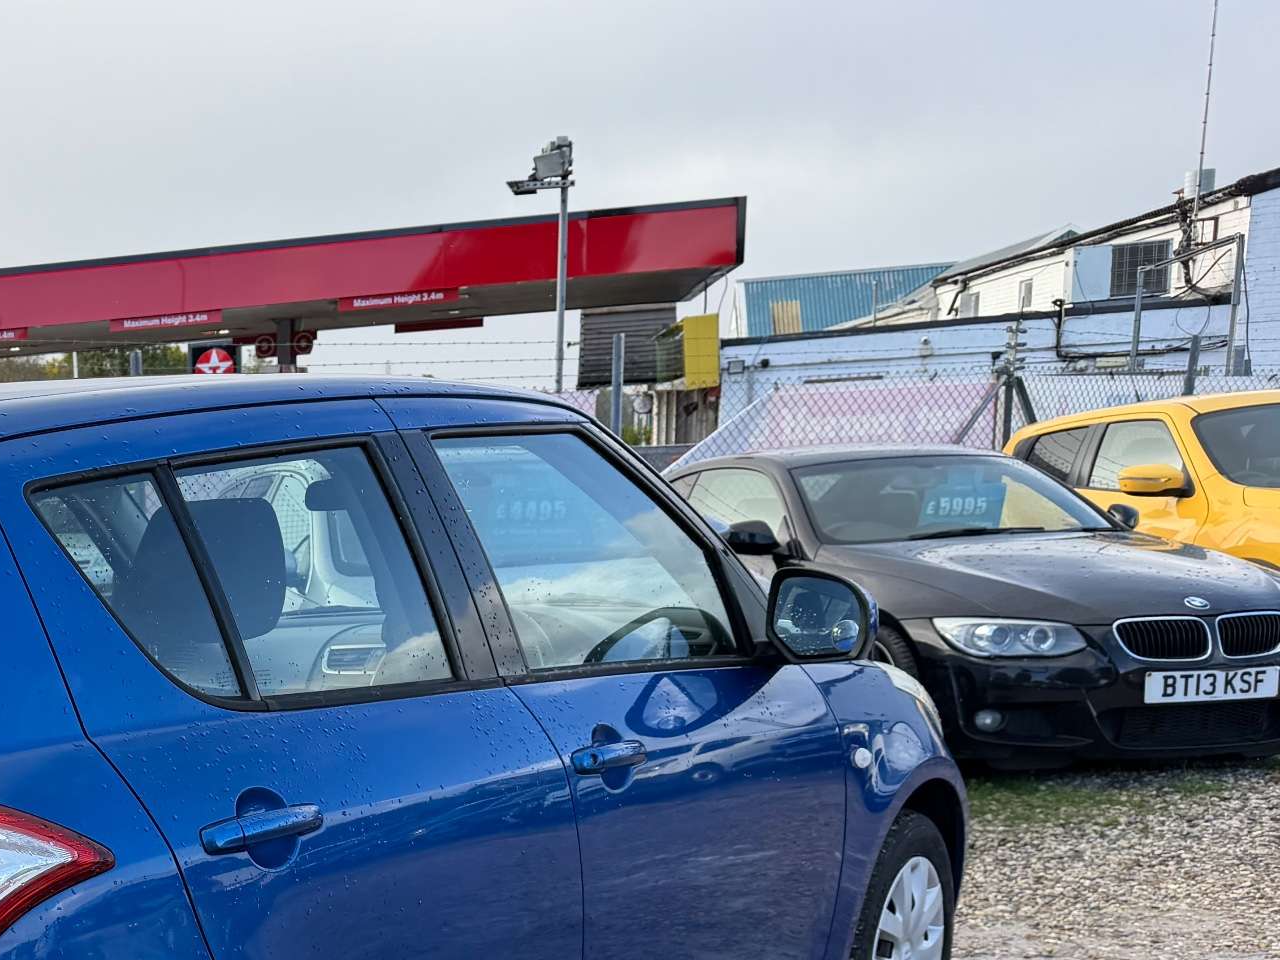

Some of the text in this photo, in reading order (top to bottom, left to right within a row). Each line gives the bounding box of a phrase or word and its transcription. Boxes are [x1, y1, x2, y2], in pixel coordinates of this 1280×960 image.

[393, 294, 421, 305] Height
[422, 292, 444, 301] 3.4m
[160, 314, 187, 325] Height
[1161, 670, 1267, 698] BT13 KSF
